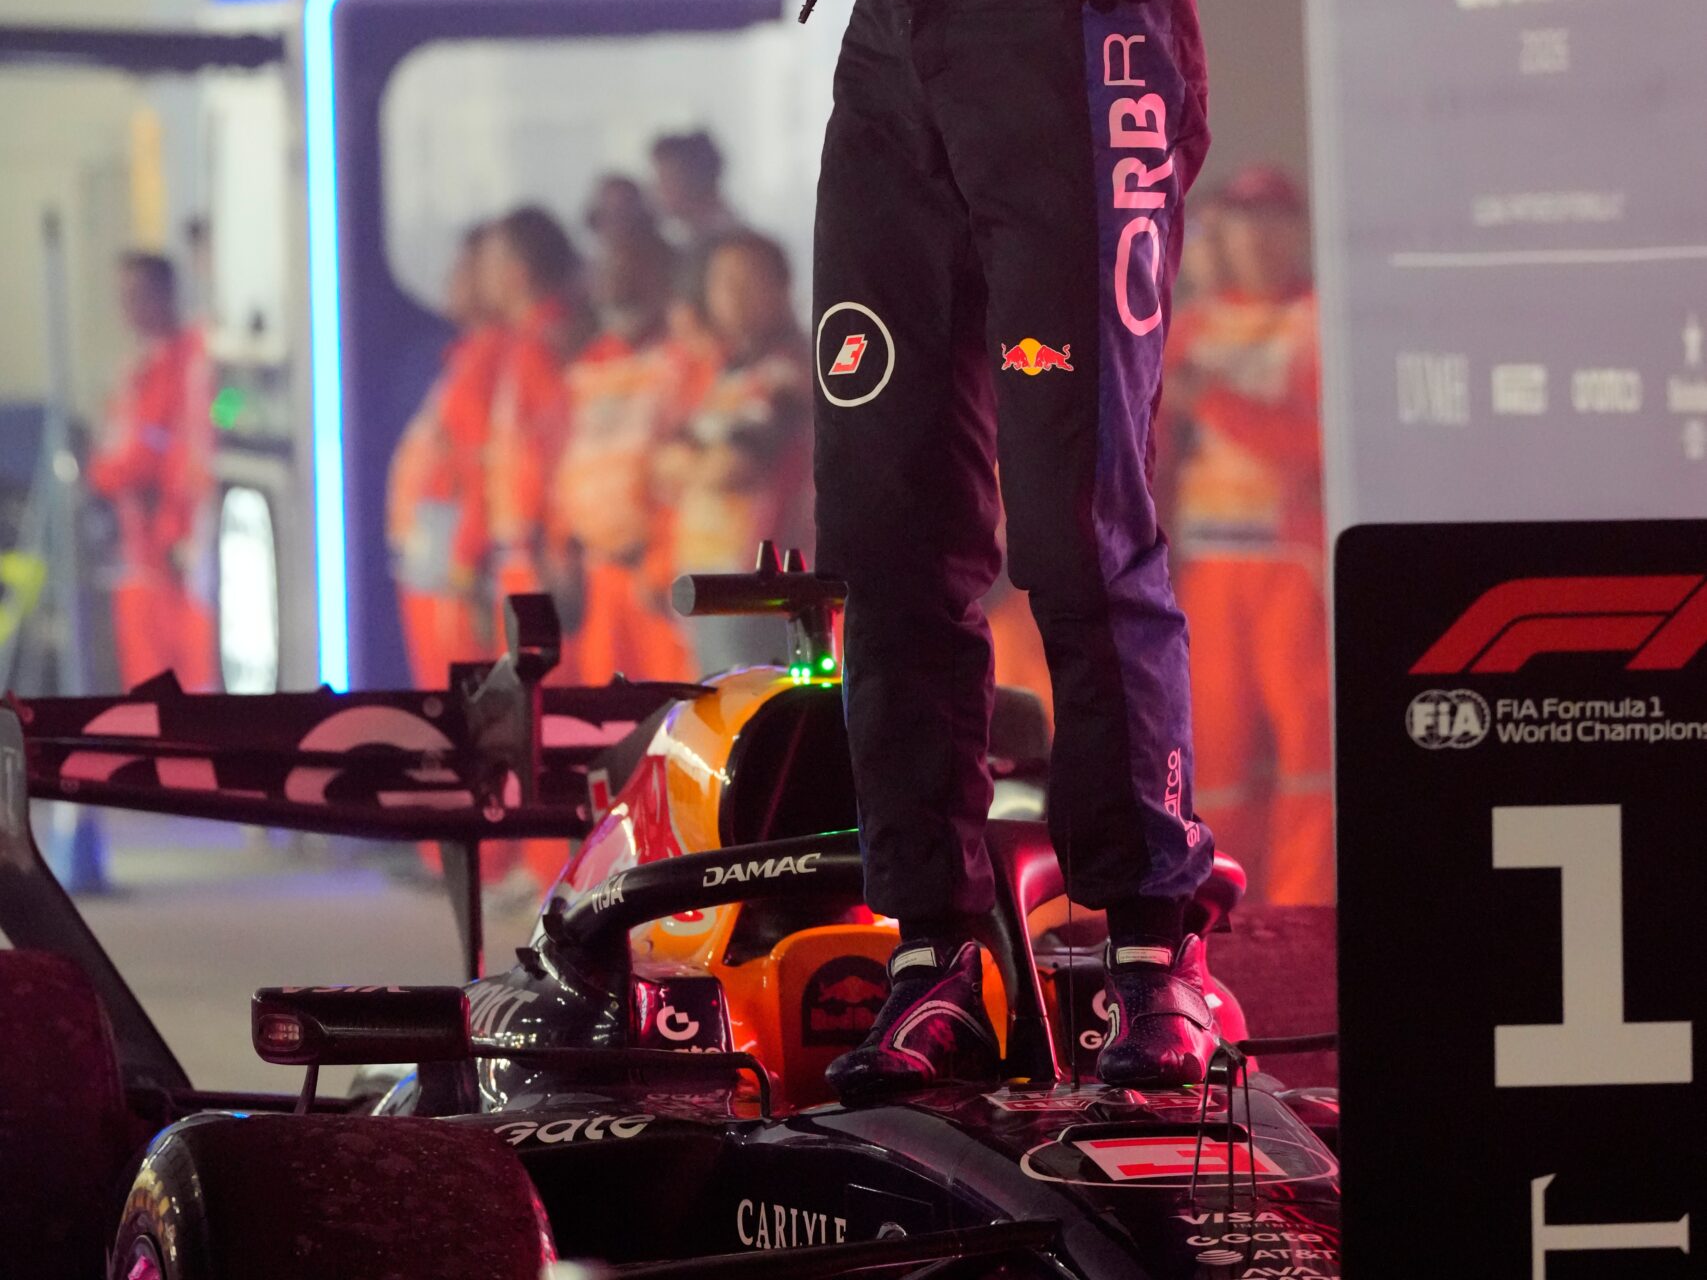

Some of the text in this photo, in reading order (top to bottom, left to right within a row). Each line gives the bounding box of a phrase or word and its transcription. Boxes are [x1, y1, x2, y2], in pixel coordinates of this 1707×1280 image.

[1496, 700, 1539, 719] FIA
[1543, 697, 1646, 719] Formula
[1649, 696, 1664, 717] 1
[1496, 724, 1573, 743] World
[702, 852, 821, 888] DAMAC
[1491, 803, 1694, 1088] 1
[1169, 1212, 1286, 1225] VISA
[1221, 1232, 1324, 1244] Gate
[1253, 1249, 1337, 1261] AT&T
[1241, 1266, 1322, 1279] AVA
